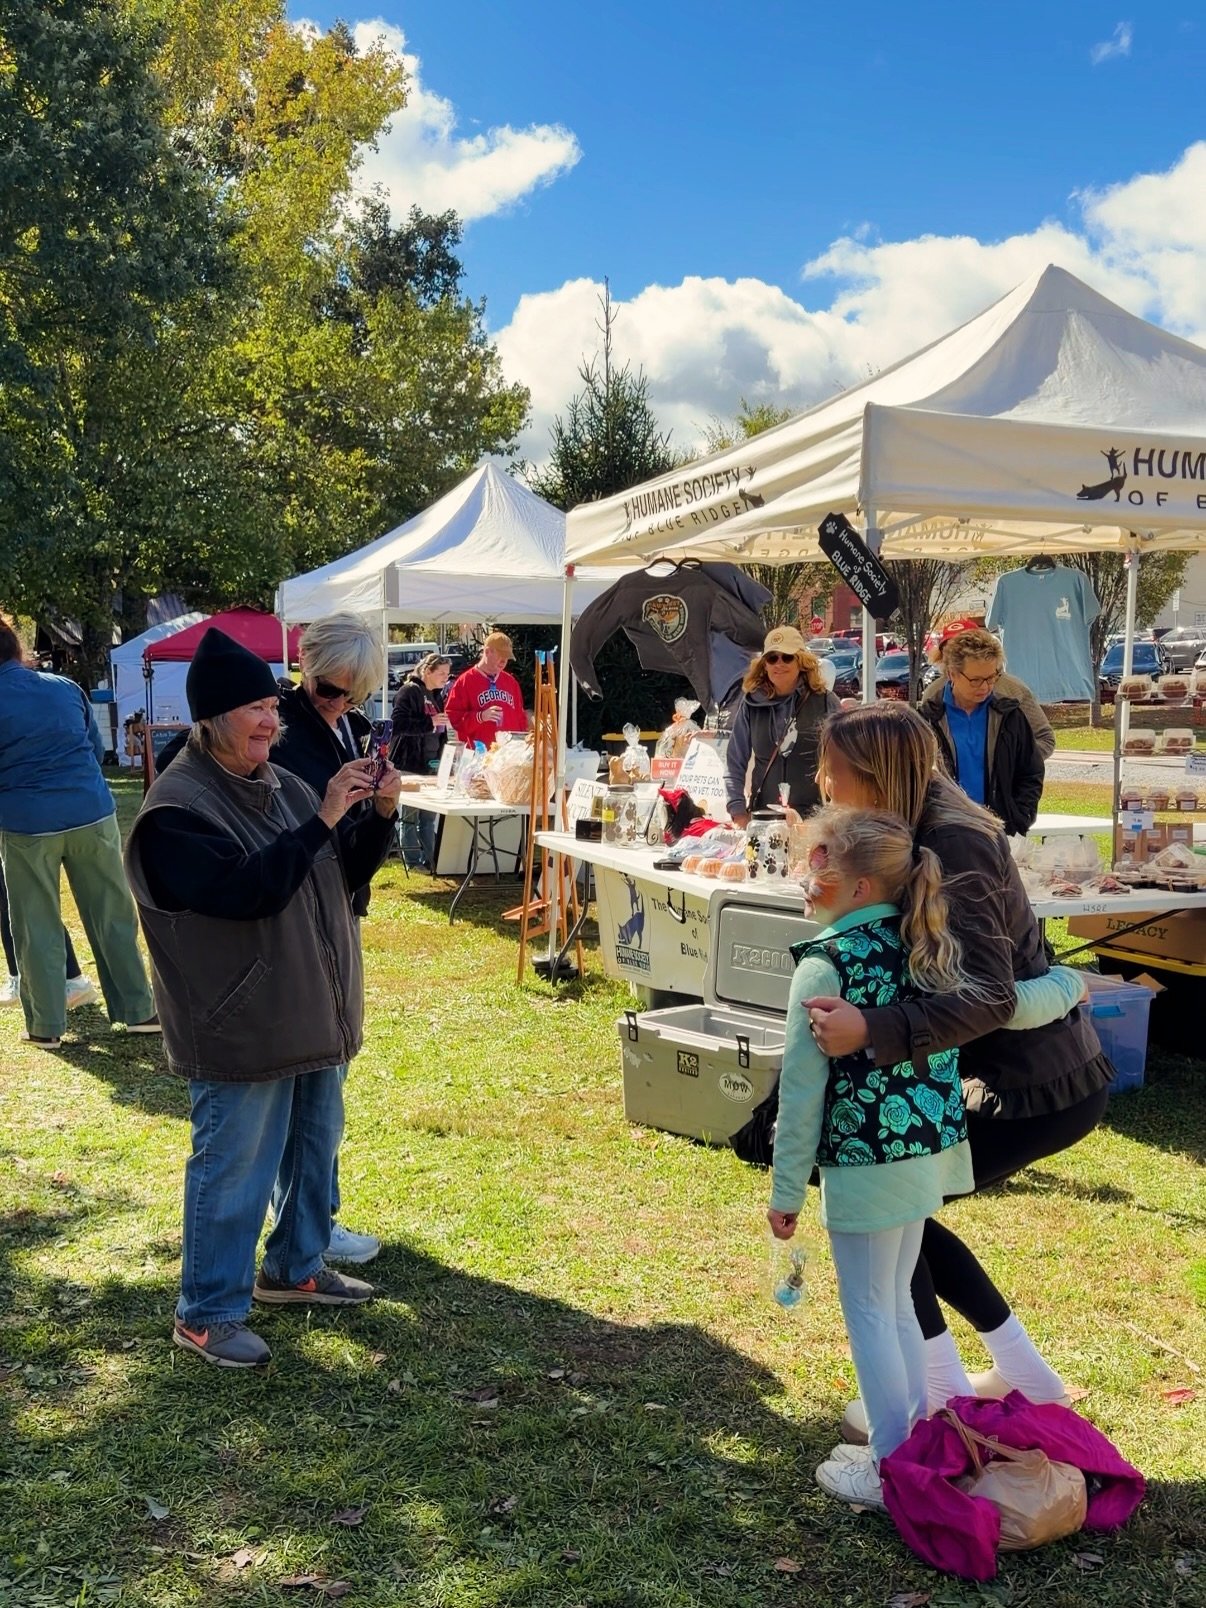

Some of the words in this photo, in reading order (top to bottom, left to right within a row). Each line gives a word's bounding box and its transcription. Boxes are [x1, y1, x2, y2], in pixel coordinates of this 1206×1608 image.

[631, 484, 683, 520] HUMANE
[683, 467, 740, 505] SOCIETY
[1128, 490, 1169, 507] OF
[691, 501, 741, 525] RIDGE
[838, 529, 865, 564] Humane
[863, 561, 887, 596] Society
[831, 550, 851, 576] BLUE
[849, 574, 872, 605] RIDGE
[477, 689, 515, 709] GEORGIA
[651, 898, 667, 912] The
[680, 942, 698, 958] Blue
[678, 1052, 697, 1067] K2
